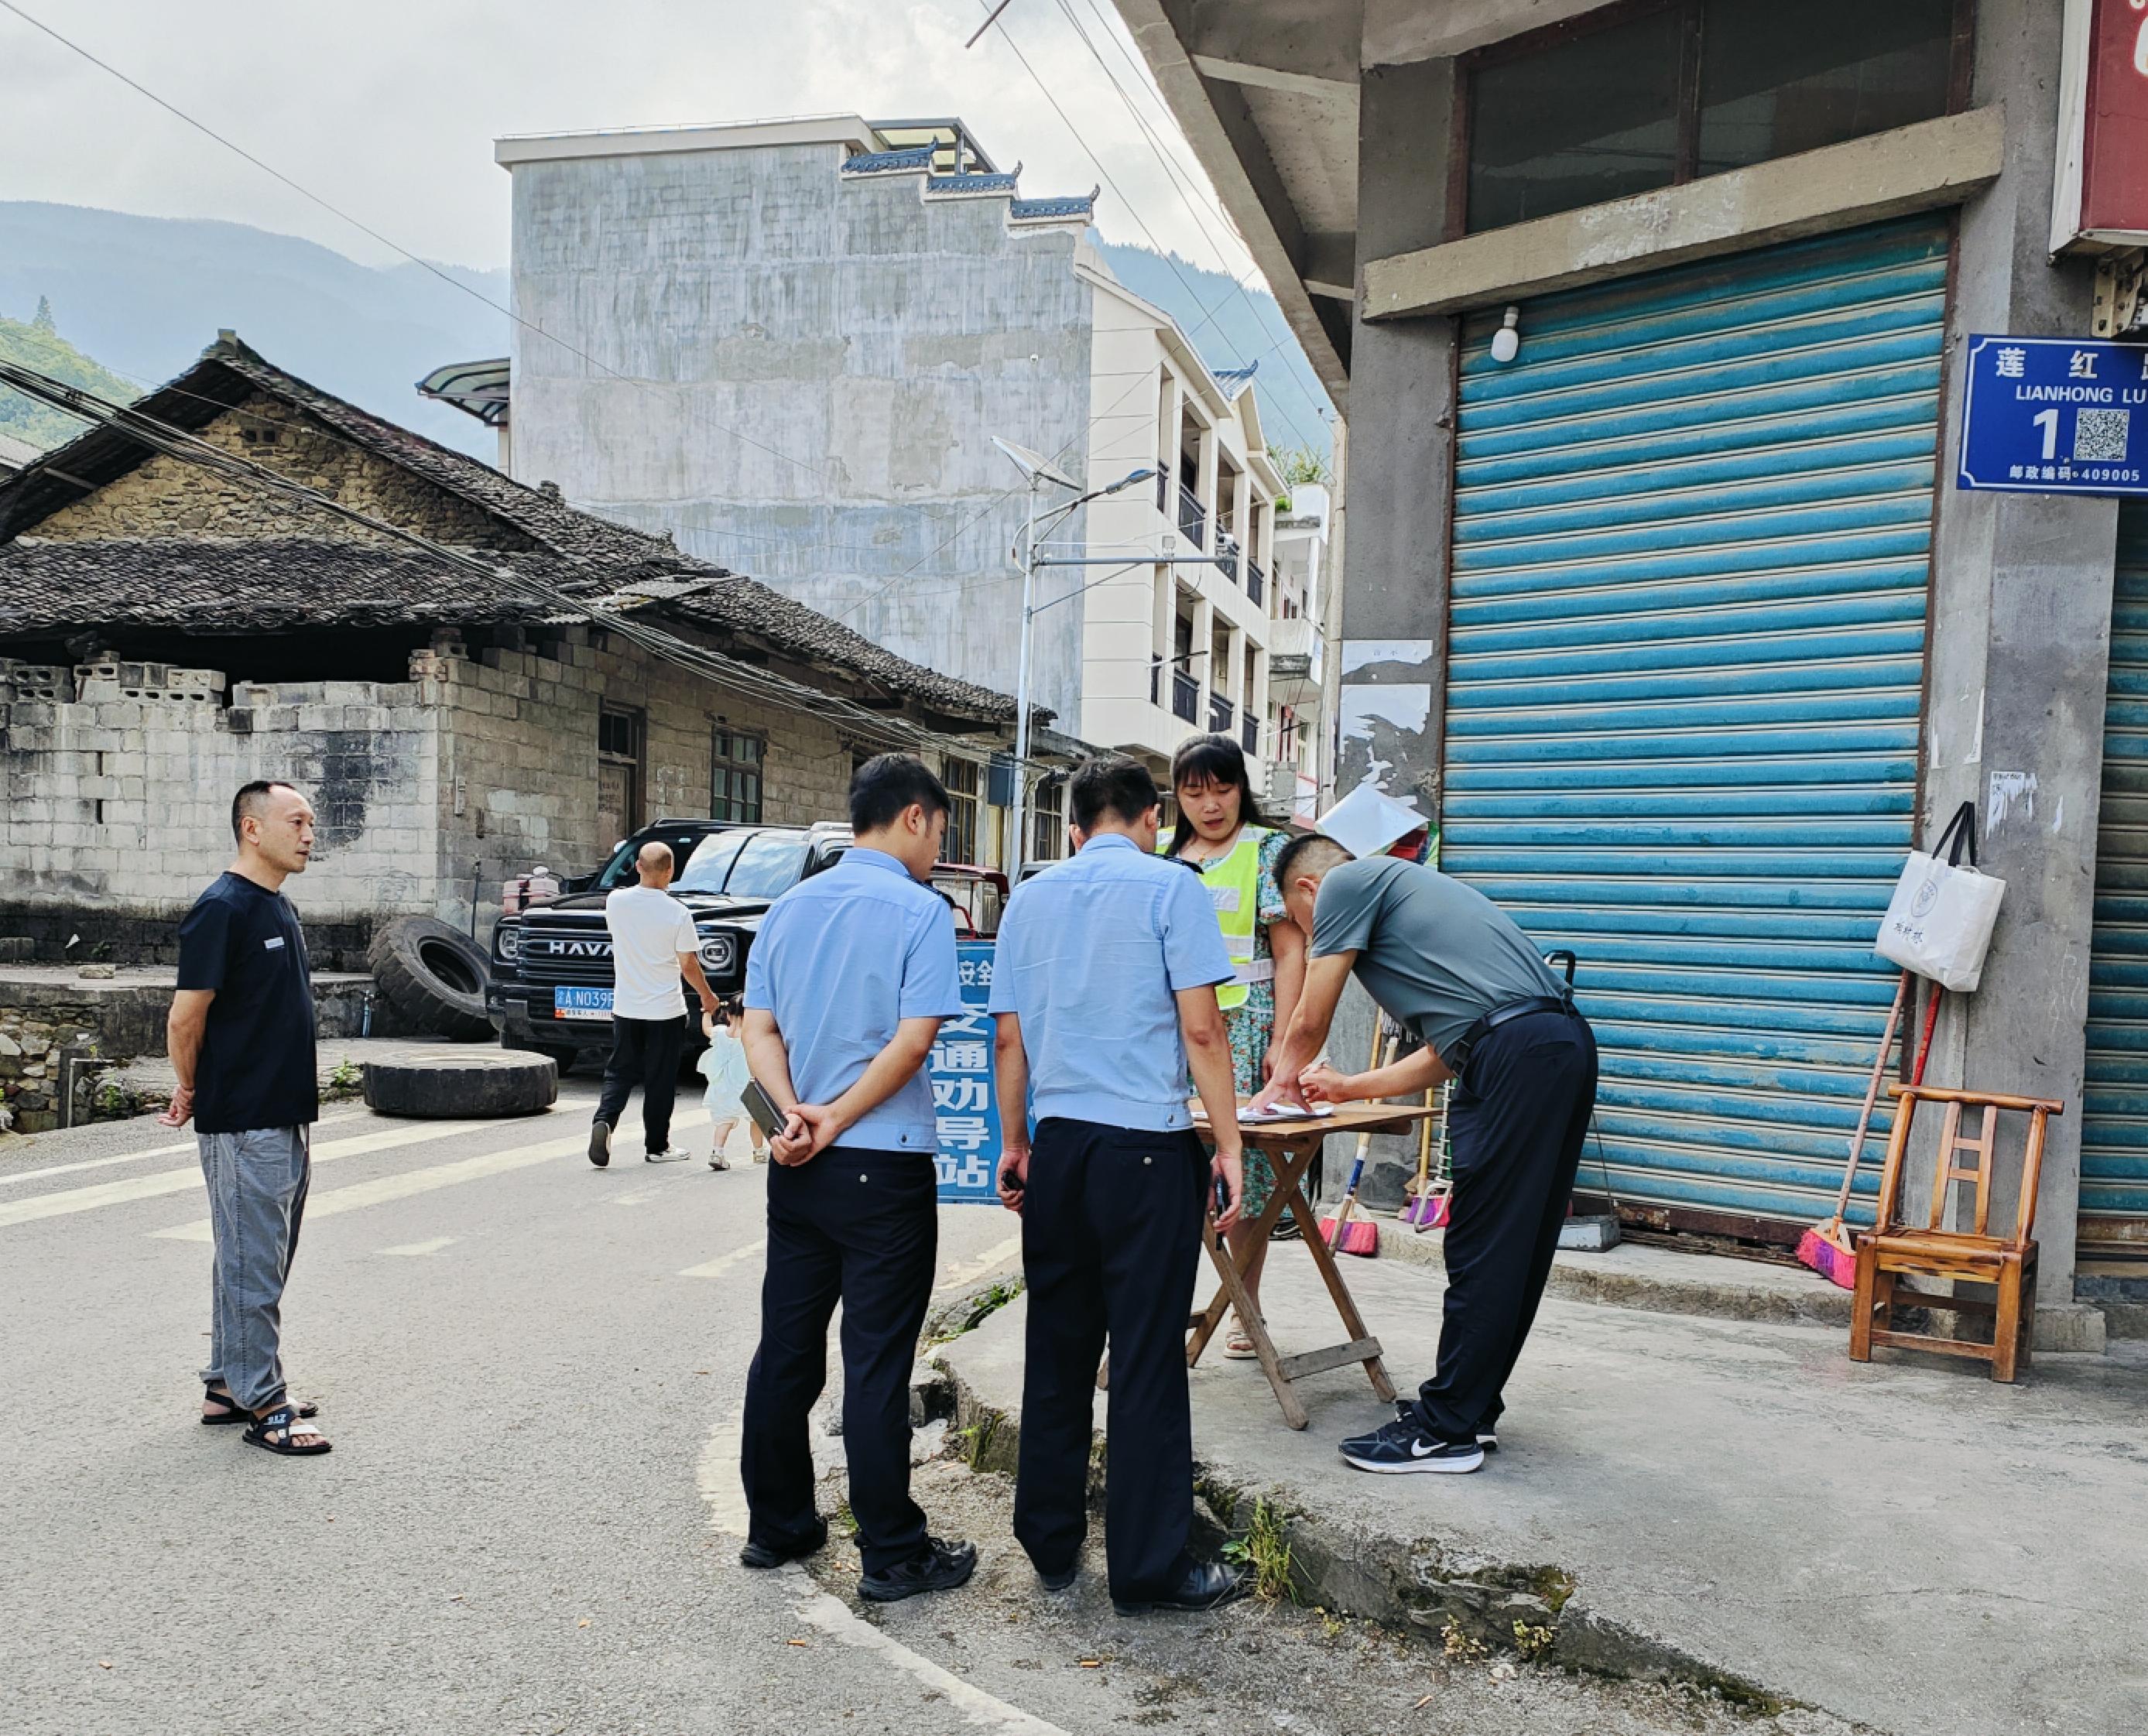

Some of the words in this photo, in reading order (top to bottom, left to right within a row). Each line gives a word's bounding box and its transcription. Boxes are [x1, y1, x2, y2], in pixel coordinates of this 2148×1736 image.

[1996, 348, 2148, 380] 莲红
[2016, 385, 2113, 402] LIANHONG
[2122, 389, 2146, 404] LU
[2033, 409, 2059, 460] 1
[550, 940, 614, 956] HAVA
[959, 960, 992, 986] 安全
